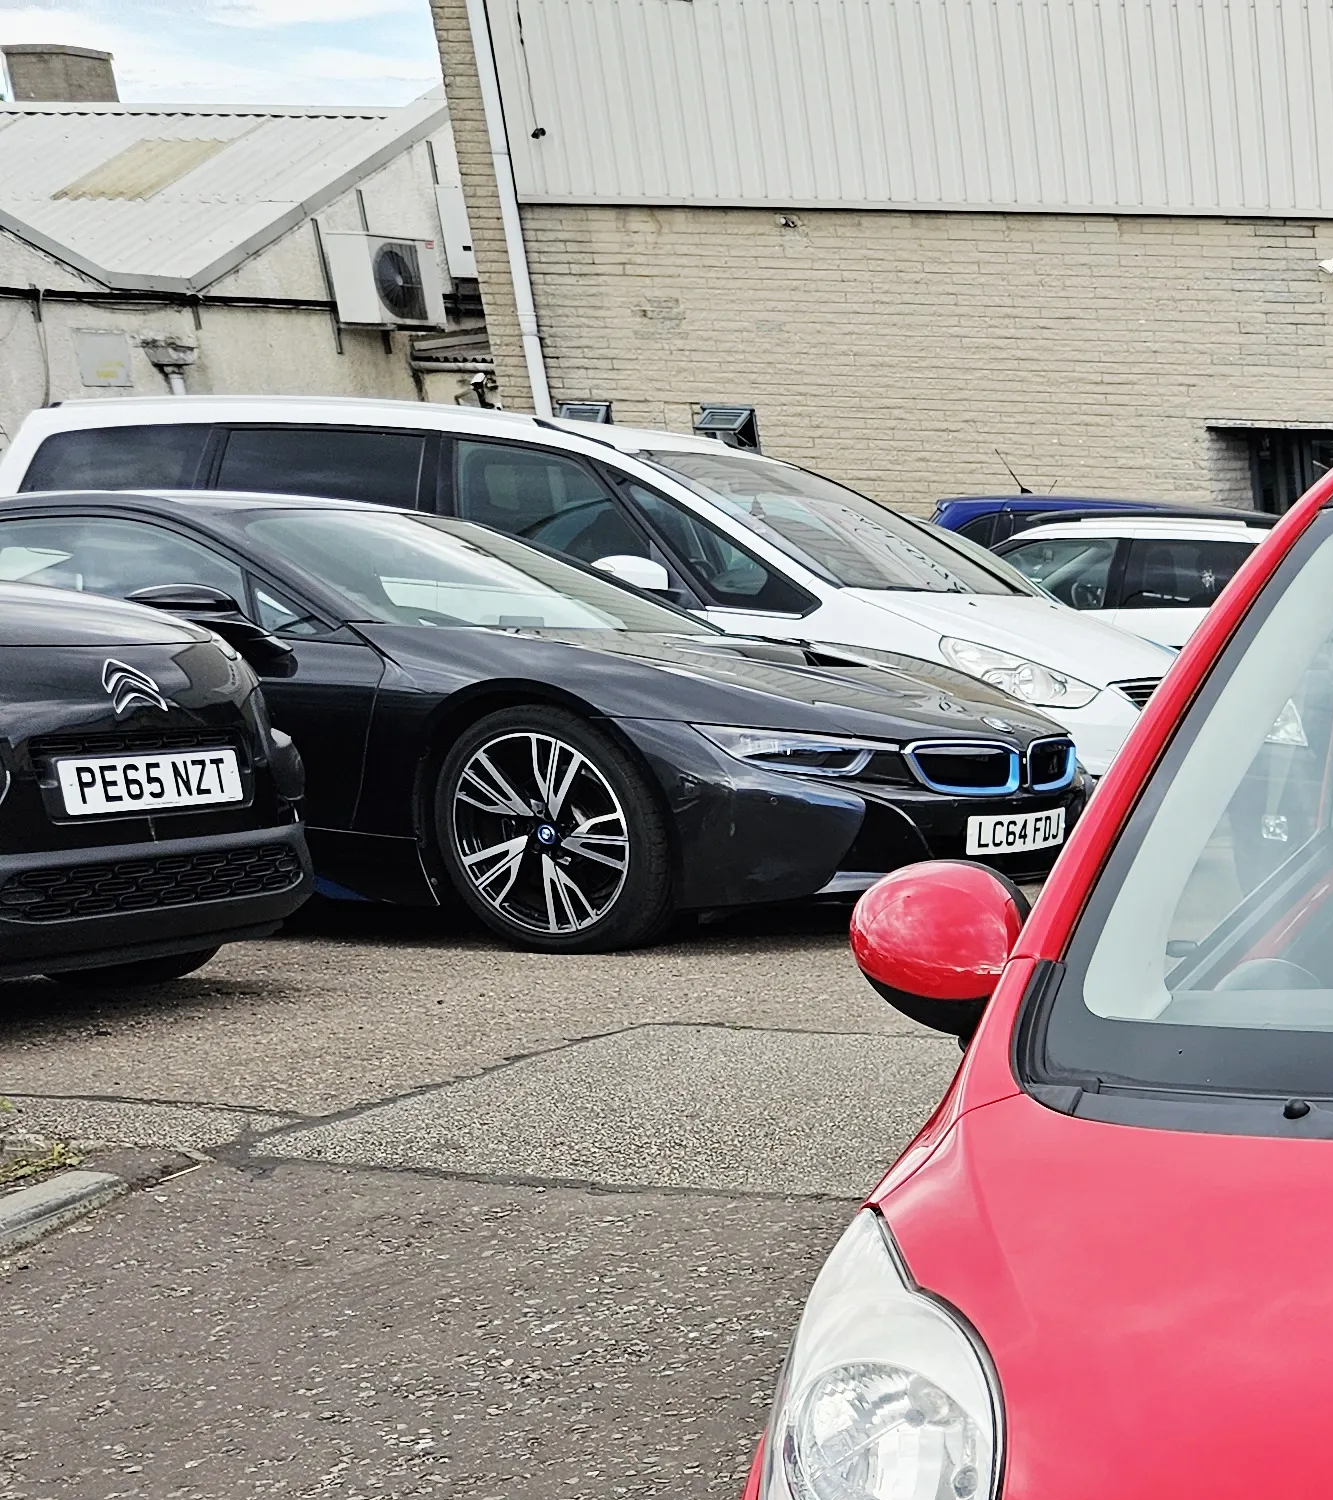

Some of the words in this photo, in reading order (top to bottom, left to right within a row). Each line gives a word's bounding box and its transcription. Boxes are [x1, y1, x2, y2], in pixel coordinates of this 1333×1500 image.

[75, 763, 165, 804] PE65
[171, 758, 225, 797] NZT
[977, 819, 1028, 848] LC64
[1033, 813, 1060, 845] FDJ
